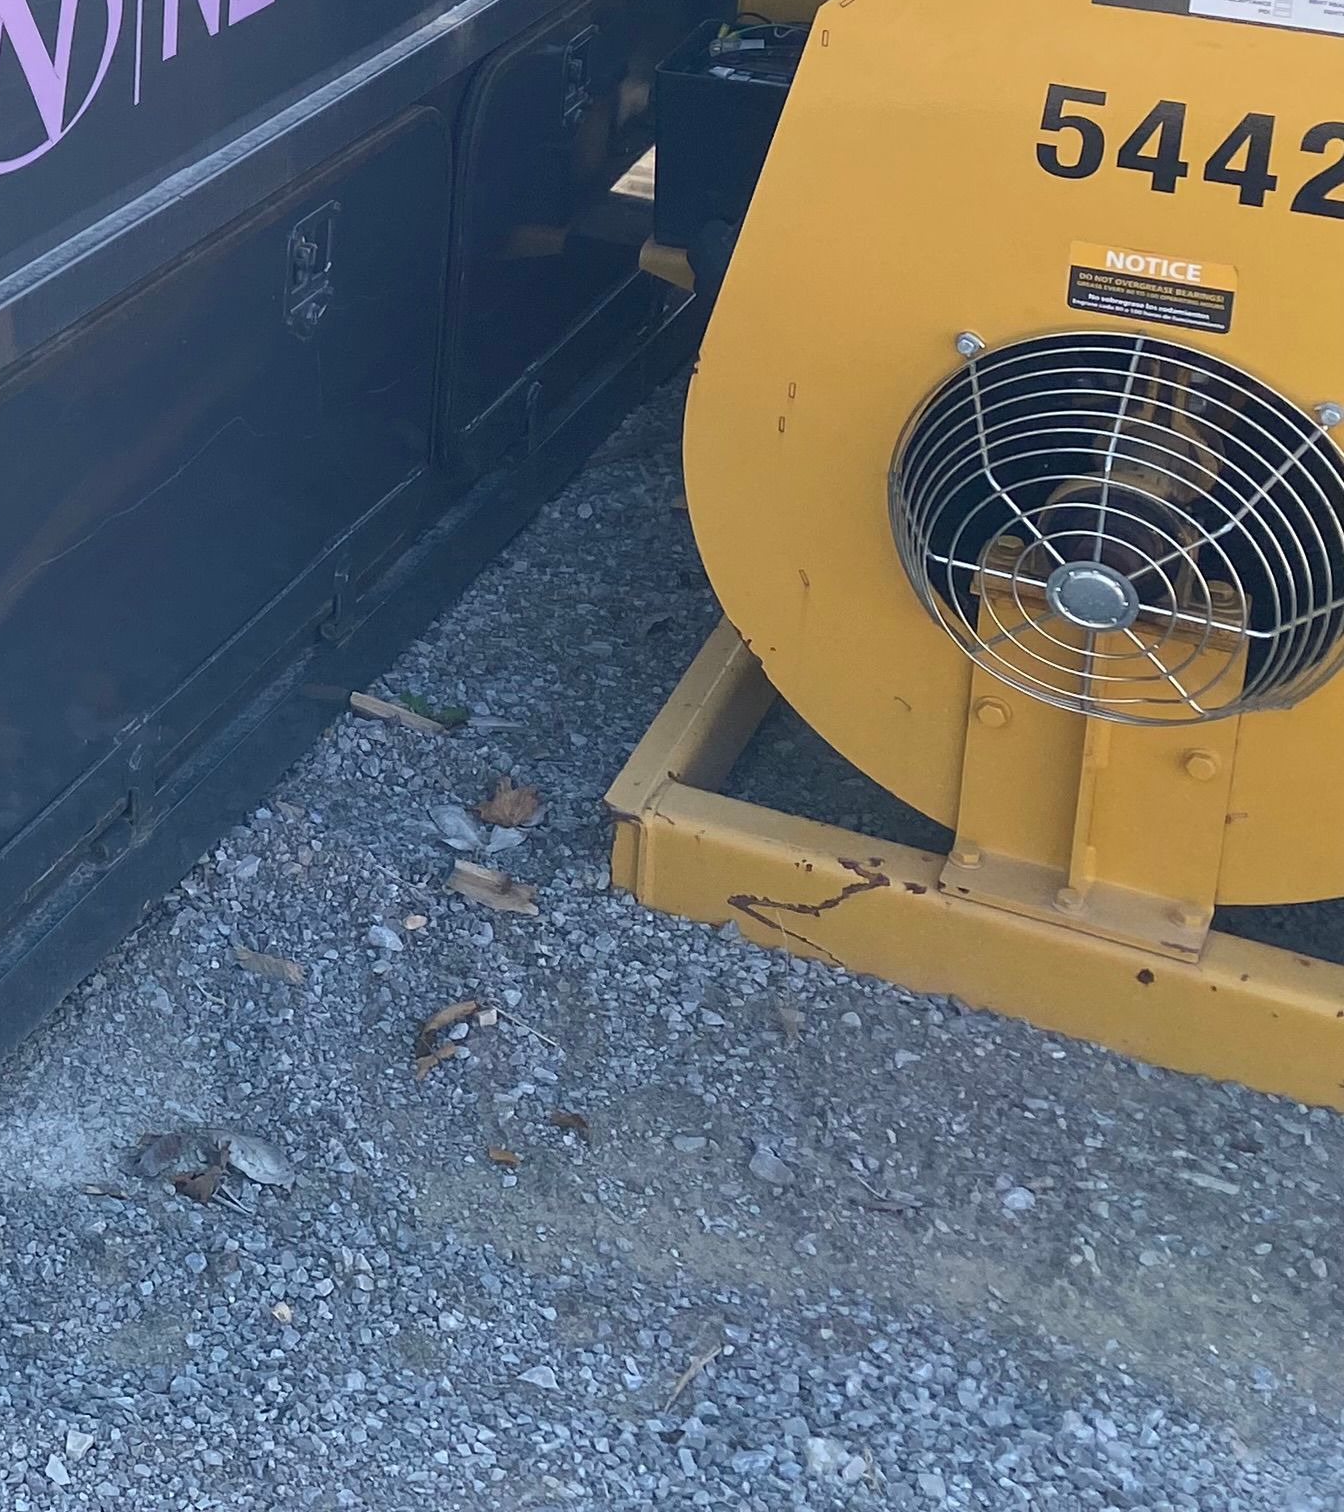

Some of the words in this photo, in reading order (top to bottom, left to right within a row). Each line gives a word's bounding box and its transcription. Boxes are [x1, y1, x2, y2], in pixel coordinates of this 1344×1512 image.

[1106, 250, 1203, 283] NOTICE
[1079, 272, 1093, 281] DO
[1094, 275, 1114, 284] NOT
[1115, 278, 1173, 295] OVERGREASE
[1176, 289, 1225, 304] BEARINGS!
[1088, 293, 1100, 301] No
